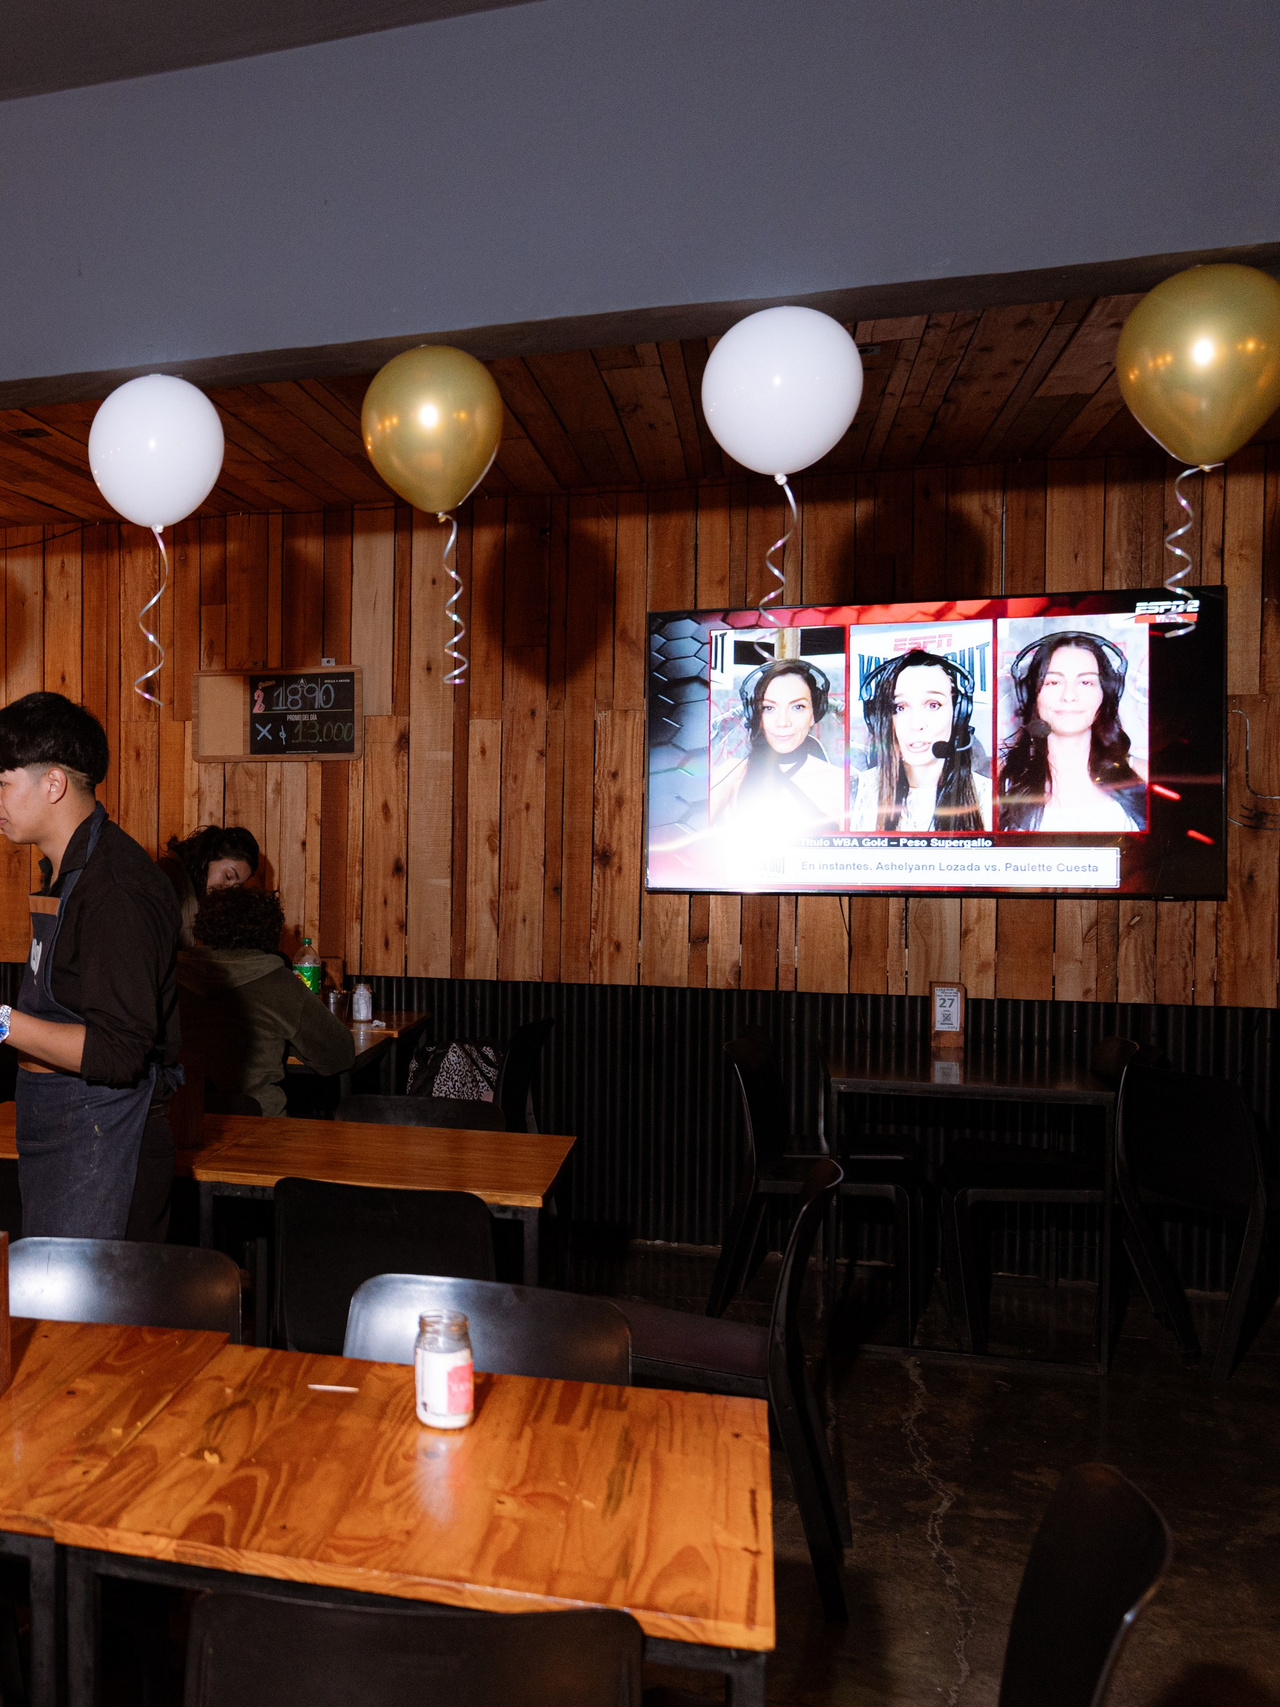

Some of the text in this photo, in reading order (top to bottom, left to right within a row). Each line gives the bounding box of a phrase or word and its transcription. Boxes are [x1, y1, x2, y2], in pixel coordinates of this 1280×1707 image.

[273, 683, 335, 710] 1890
[833, 838, 859, 847] WBA
[862, 838, 888, 847] Gold
[899, 838, 927, 847] Peso
[930, 838, 993, 848] Supergallo
[801, 861, 815, 870] En
[876, 861, 936, 874] Ashelyann
[939, 861, 981, 872] Lozada
[984, 863, 1001, 872] vs.
[1005, 862, 1053, 872] Paulette
[1056, 862, 1099, 873] Cuesta
[939, 998, 955, 1008] 27
